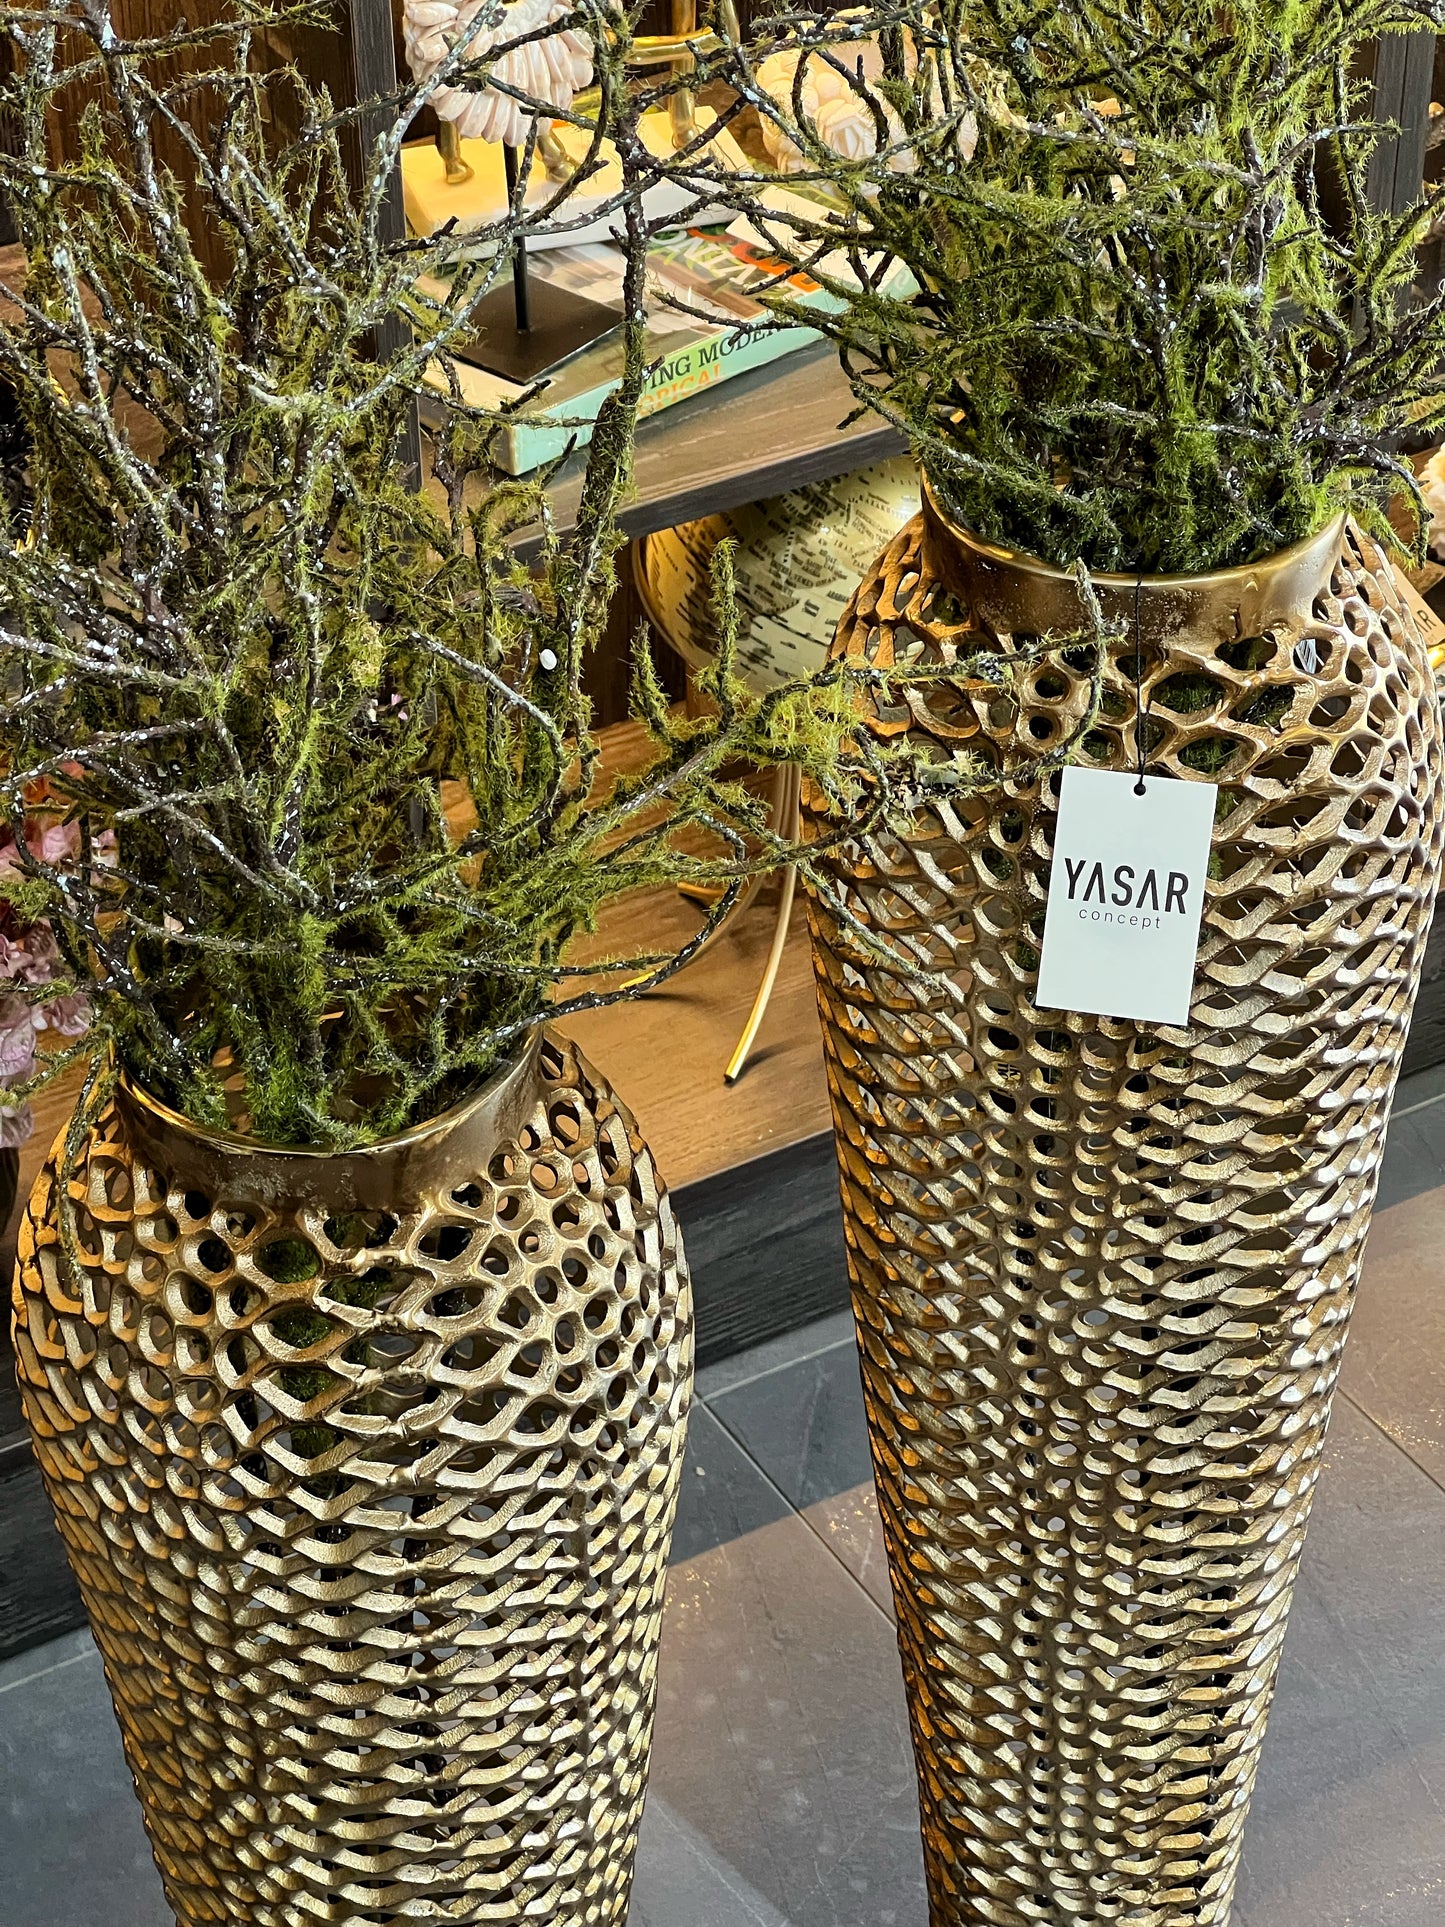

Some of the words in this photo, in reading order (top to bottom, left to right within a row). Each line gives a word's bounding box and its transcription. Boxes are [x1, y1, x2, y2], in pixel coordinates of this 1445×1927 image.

[698, 328, 777, 368] MODE
[1064, 858, 1189, 915] YASAR
[1079, 909, 1161, 930] concept
